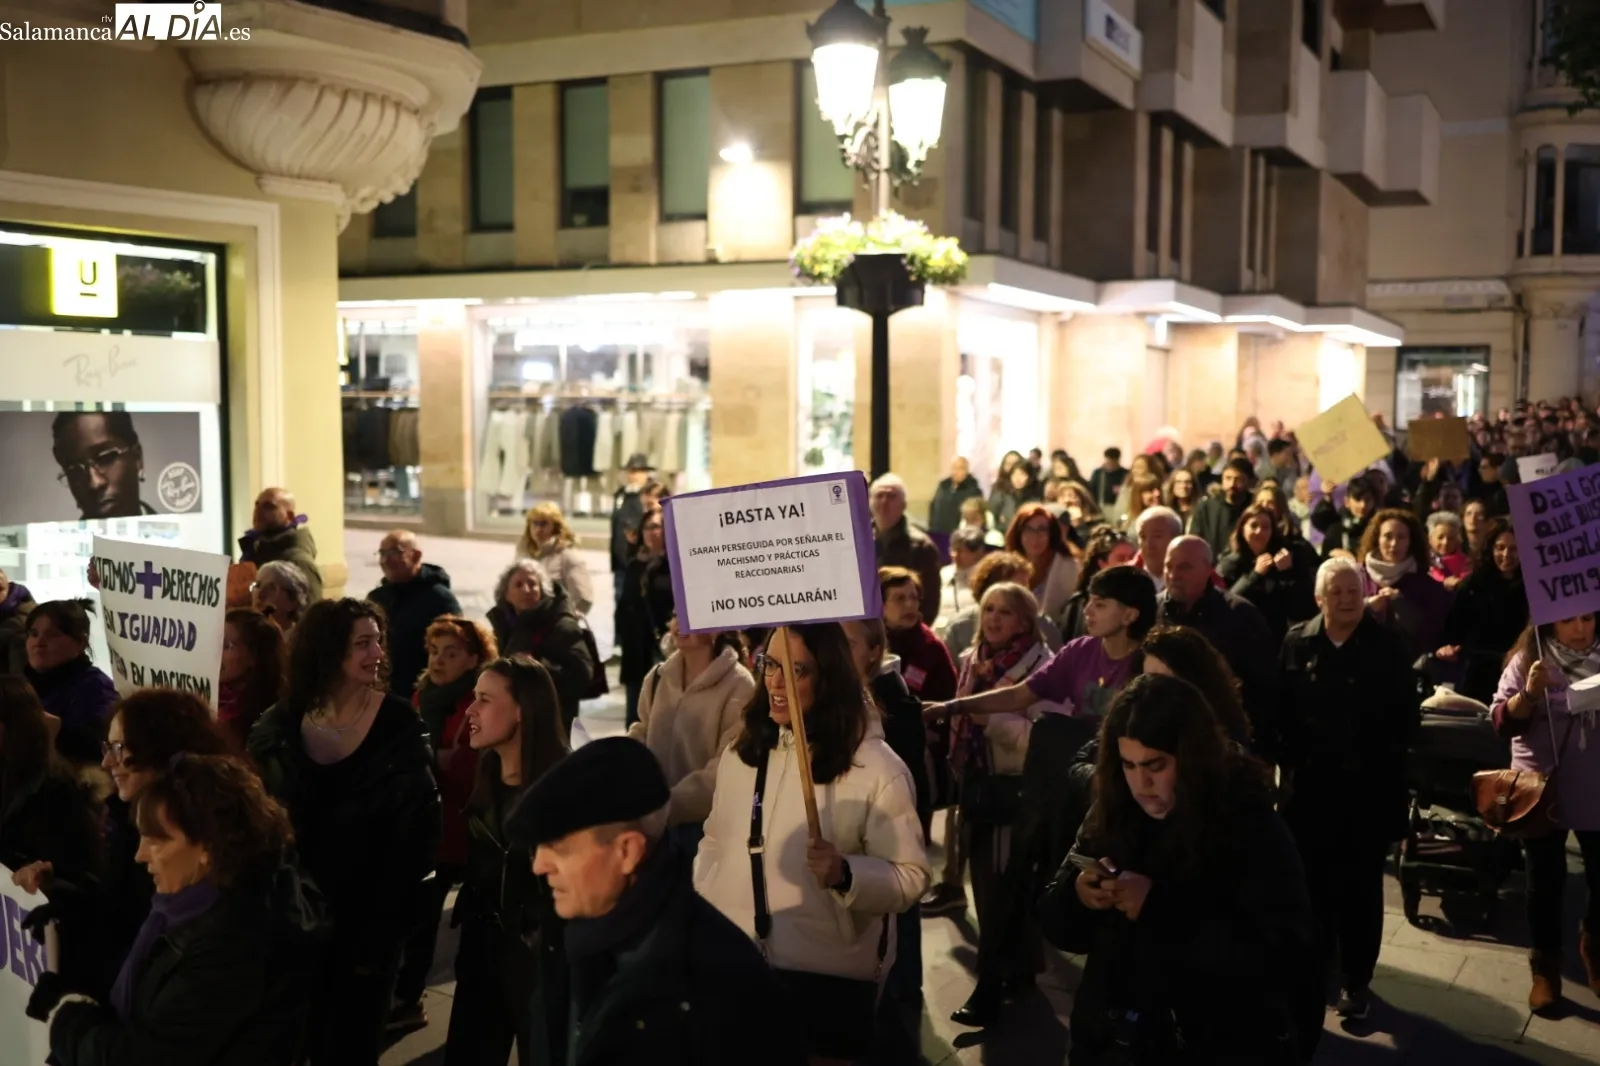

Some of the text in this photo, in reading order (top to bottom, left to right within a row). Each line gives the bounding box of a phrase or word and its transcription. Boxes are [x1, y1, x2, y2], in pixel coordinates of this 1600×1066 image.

[719, 502, 805, 528] ¡BASTA YA!
[689, 532, 845, 556] ¡SARAH PERSEGUIDA POR SEÑALAR EL
[717, 548, 820, 567] MACHISMO Y PRÁCTICAS
[735, 564, 805, 579] REACCIONARIAS!
[161, 566, 221, 608] DERECHOS
[711, 587, 838, 613] ¡NO NOS CALLARÁN!
[117, 611, 197, 651] IGUALDAD
